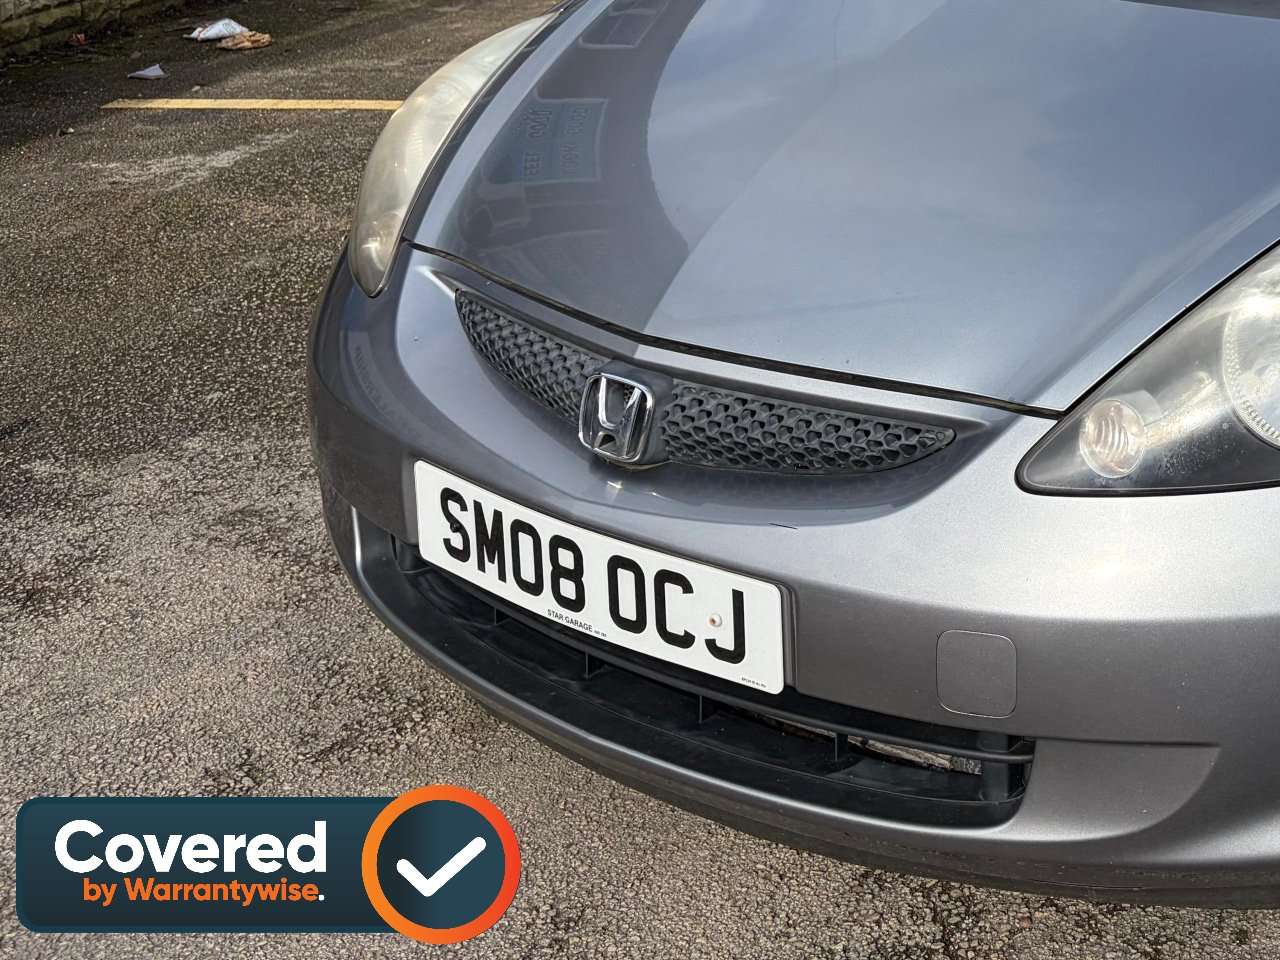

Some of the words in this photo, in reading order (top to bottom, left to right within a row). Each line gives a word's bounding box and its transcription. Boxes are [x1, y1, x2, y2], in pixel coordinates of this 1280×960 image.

[440, 487, 586, 613] SM08
[607, 554, 746, 665] OCJ
[547, 609, 564, 621] STAR
[564, 616, 593, 633] GARAGE
